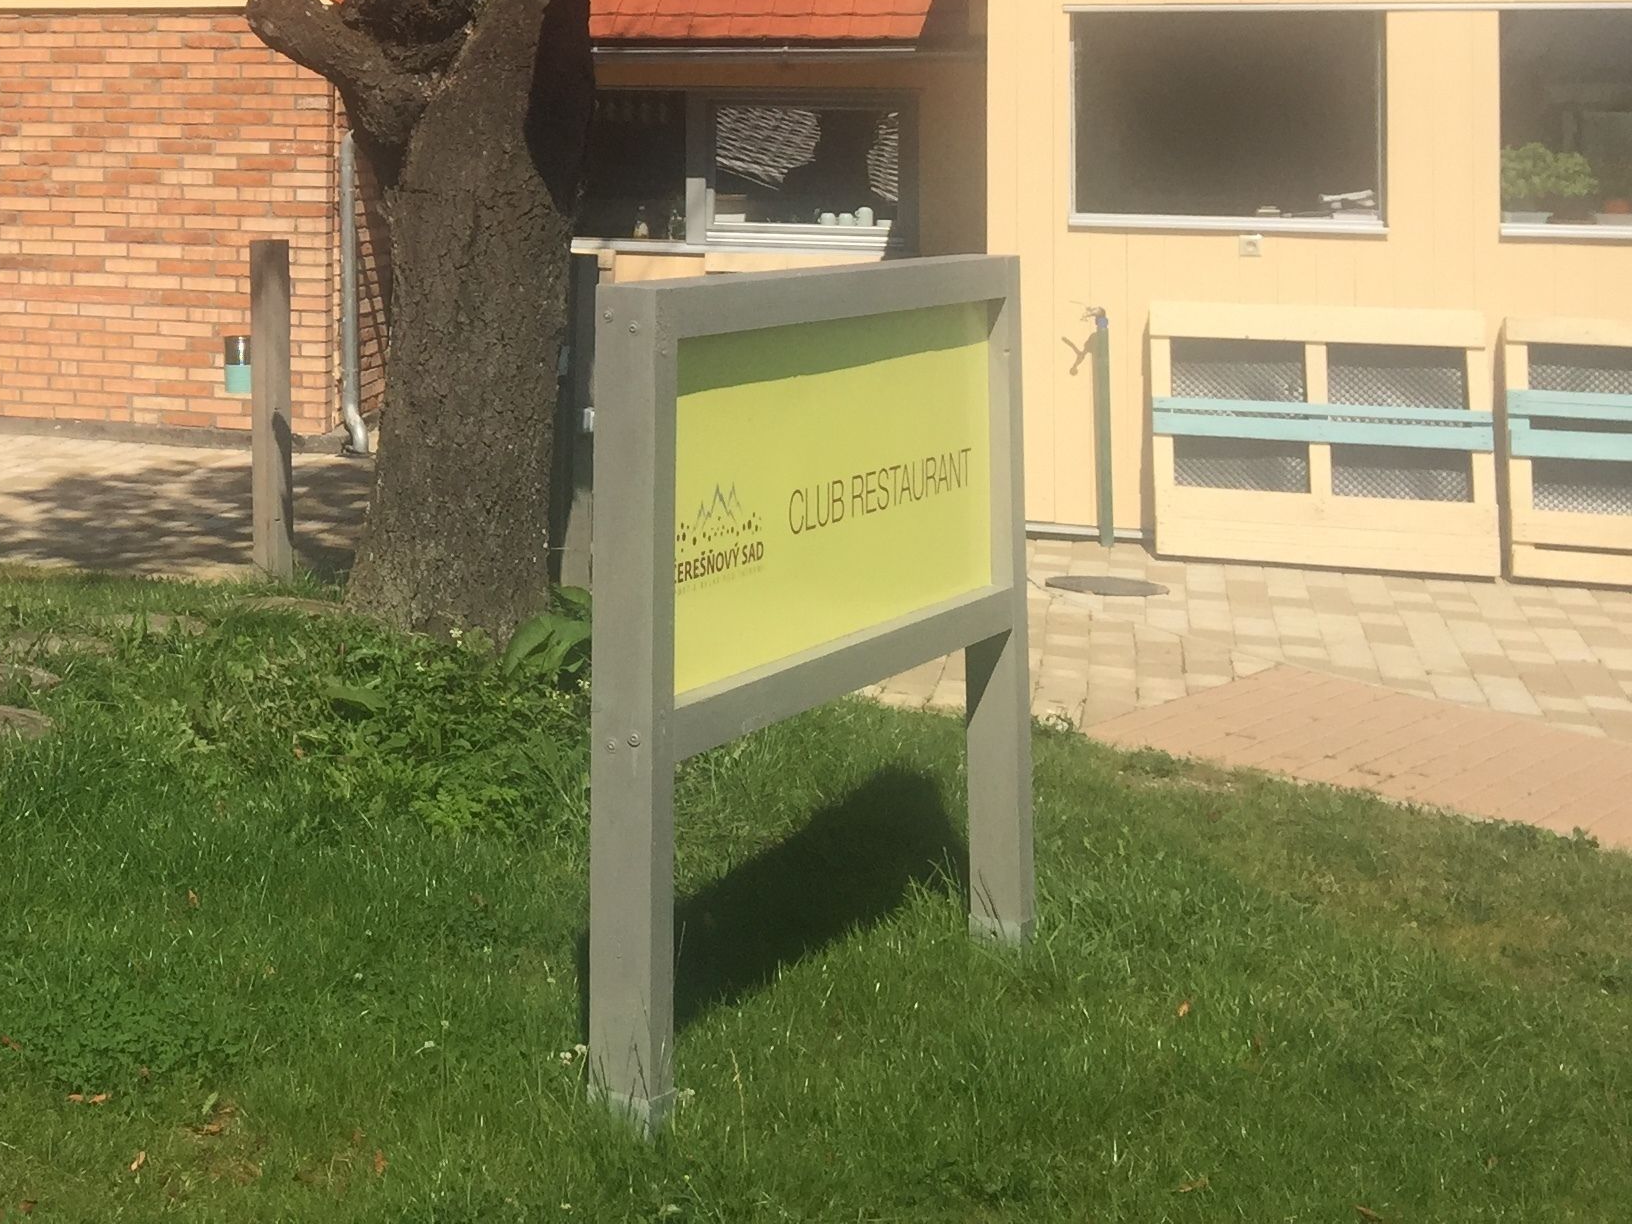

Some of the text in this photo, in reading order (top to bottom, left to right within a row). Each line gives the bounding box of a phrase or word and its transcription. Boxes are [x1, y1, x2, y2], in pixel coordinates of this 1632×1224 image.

[788, 448, 972, 535] CLUB RESTAURANT
[742, 541, 764, 565] SAD
